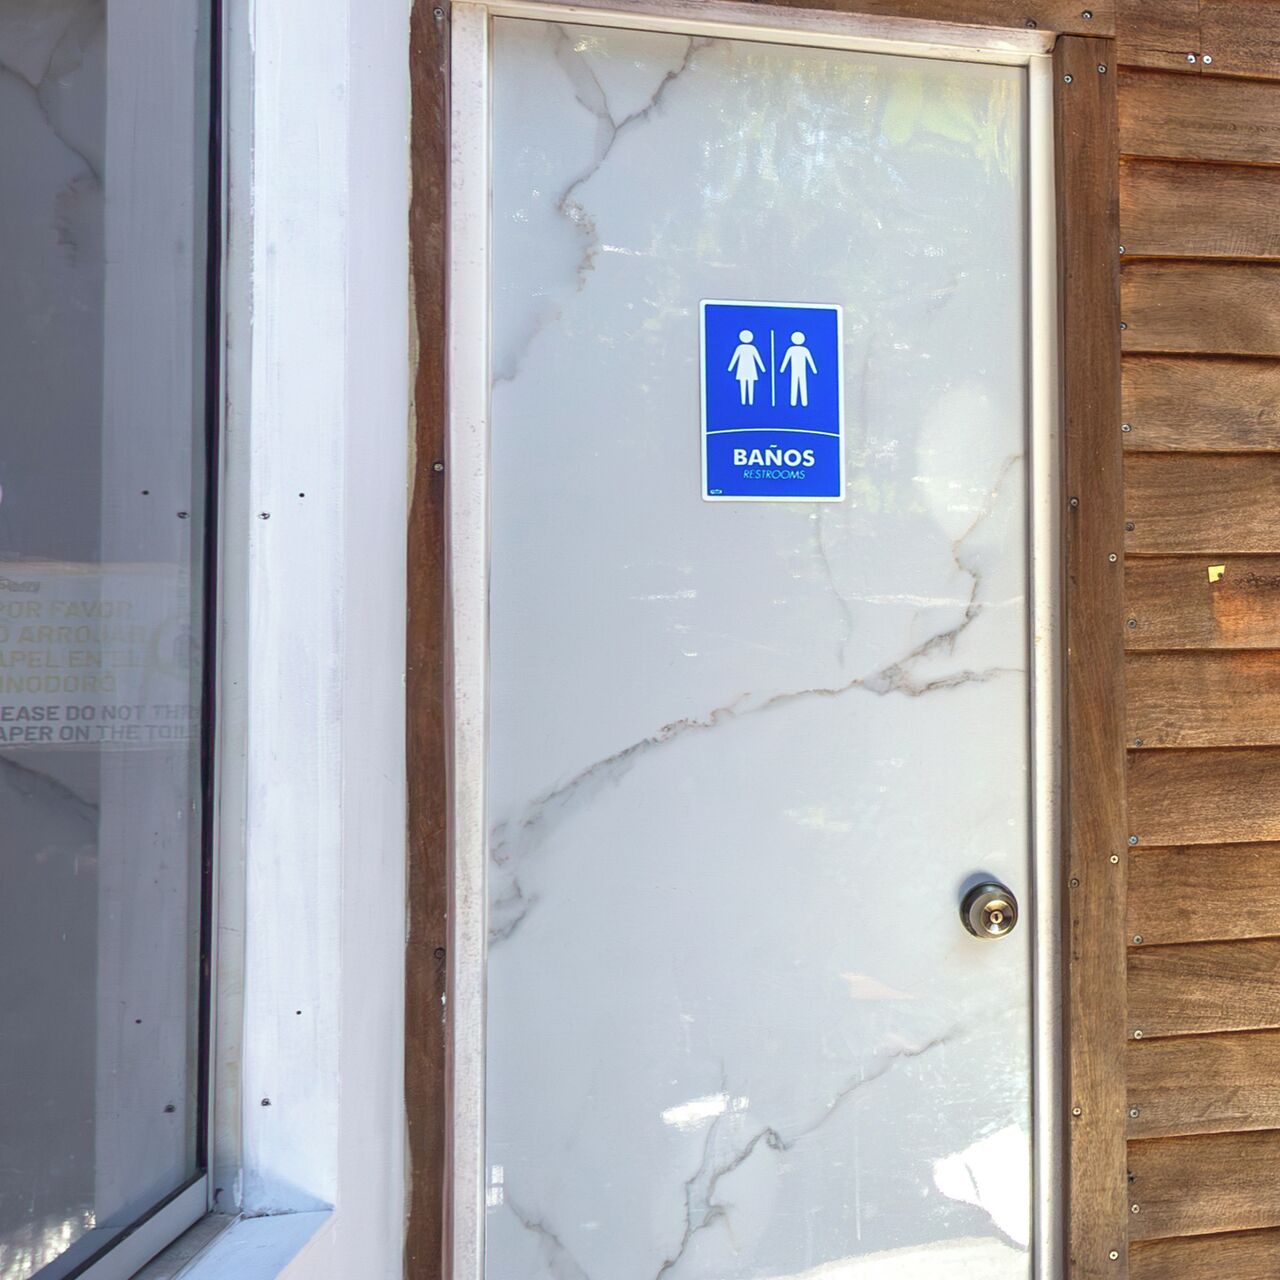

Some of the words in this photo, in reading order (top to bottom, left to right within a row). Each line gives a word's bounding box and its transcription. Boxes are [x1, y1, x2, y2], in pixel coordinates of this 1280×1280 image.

[733, 444, 815, 467] BAÑOS
[743, 469, 806, 480] RESTROOMS
[0, 706, 60, 721] EASE
[66, 706, 96, 721] DO
[102, 705, 146, 721] NOT
[0, 726, 54, 741] APER
[59, 726, 90, 741] ON
[97, 725, 139, 740] THE
